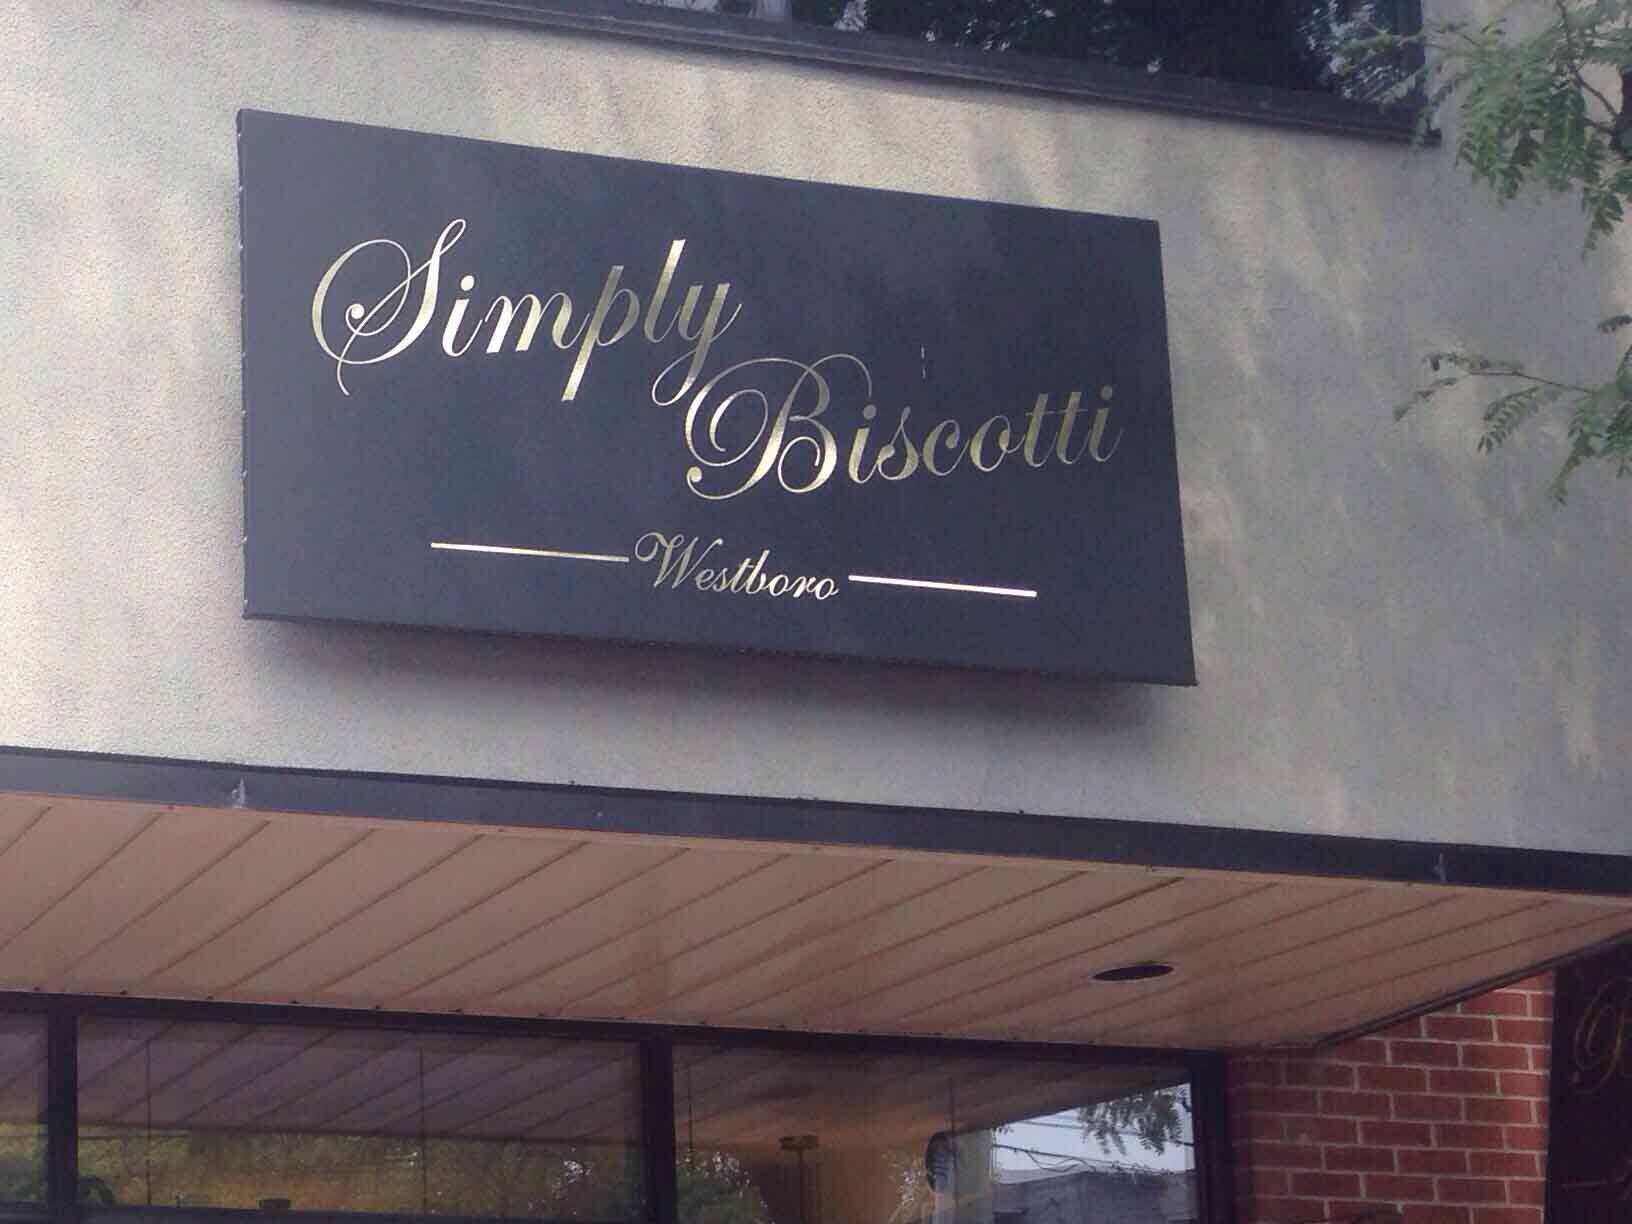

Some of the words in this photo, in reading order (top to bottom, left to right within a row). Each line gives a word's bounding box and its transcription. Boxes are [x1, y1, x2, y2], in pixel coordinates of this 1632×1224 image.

[311, 217, 742, 406] Simply
[683, 353, 1121, 501] Biscotti
[634, 531, 839, 601] Westboro
